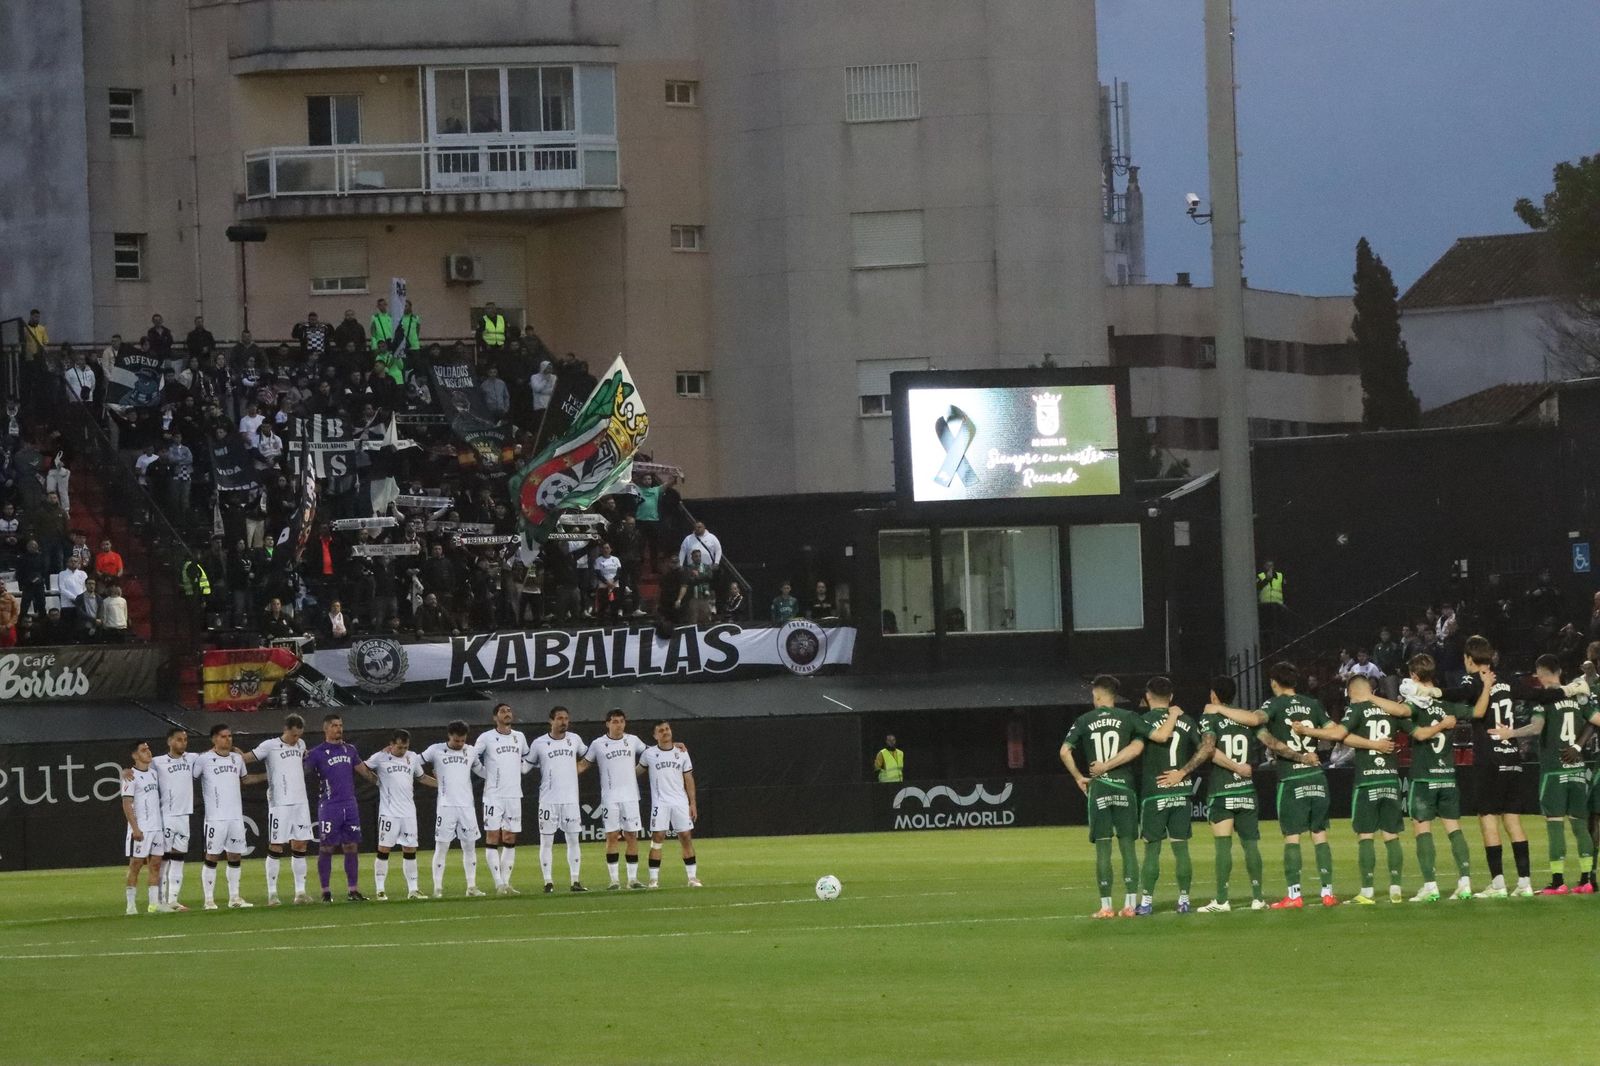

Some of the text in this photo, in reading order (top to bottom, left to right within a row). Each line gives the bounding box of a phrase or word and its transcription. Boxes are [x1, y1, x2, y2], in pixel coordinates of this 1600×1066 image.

[124, 355, 159, 368] DEFEND
[987, 445, 1105, 472] Siempre en nuestro
[216, 465, 242, 476] VIDA
[1022, 467, 1079, 488] Recuerdo
[788, 621, 813, 630] FRENTE
[446, 623, 742, 688] KABALLAS
[23, 654, 56, 670] Café
[0, 653, 90, 699] Borrás
[1427, 706, 1446, 718] CASTR
[1088, 718, 1122, 731] VICENTE
[1560, 711, 1576, 746] 4
[1284, 718, 1316, 753] 32
[496, 746, 520, 754] CEUTA
[1090, 730, 1120, 763] 10
[1220, 733, 1248, 765] 19
[548, 749, 574, 759] CEUTA
[605, 750, 632, 760] CEUTA
[327, 755, 351, 766] CEUTA
[442, 756, 469, 766] CEUTA
[655, 761, 681, 771] CEUTA
[168, 763, 191, 774] CEUTA
[213, 765, 238, 775] CEUTA
[386, 765, 411, 774] CEUTA
[0, 755, 123, 806] uta
[143, 783, 158, 793] CEUT
[485, 805, 494, 816] 14
[539, 809, 550, 821] 20
[601, 808, 608, 818] 2
[653, 807, 659, 817] 3
[272, 818, 279, 829] 6
[894, 810, 1015, 830] MOLCAWORLD
[321, 820, 331, 833] 13
[380, 820, 392, 832] 19
[208, 827, 215, 838] 8
